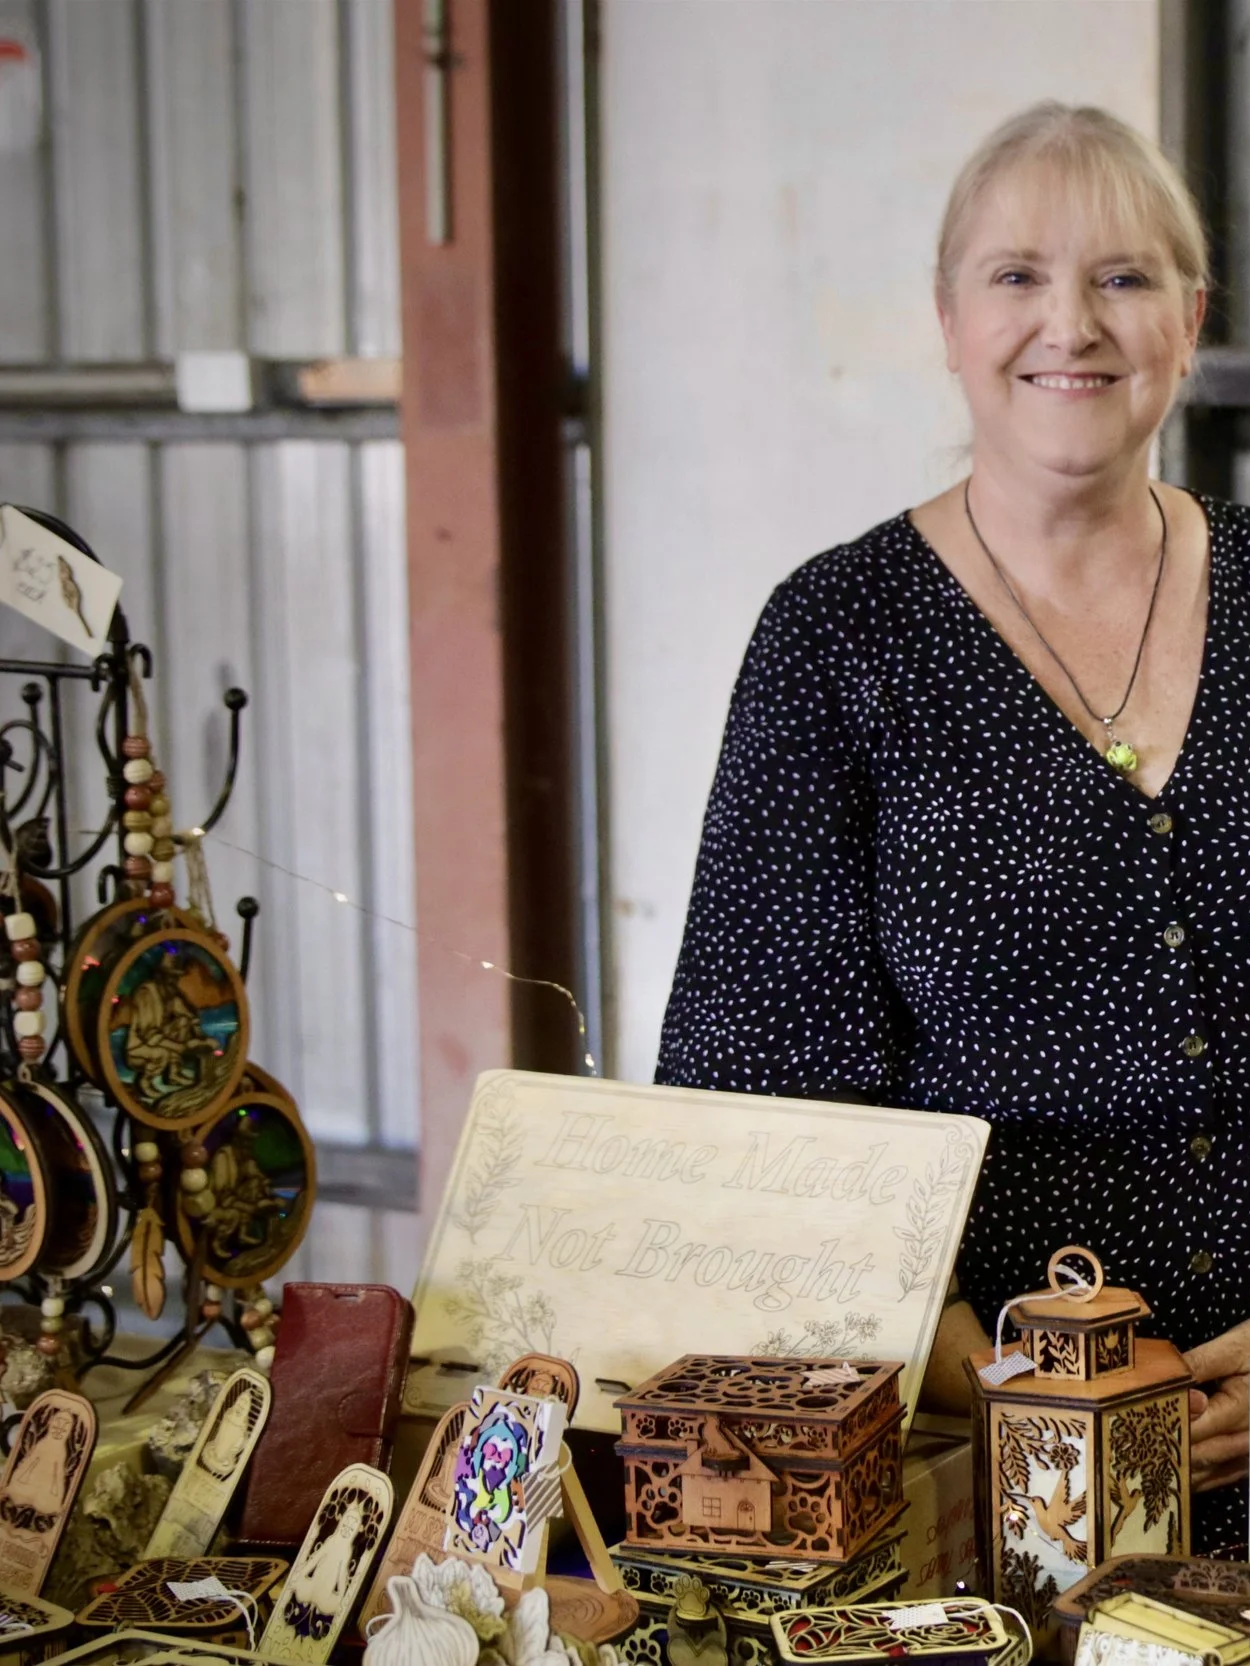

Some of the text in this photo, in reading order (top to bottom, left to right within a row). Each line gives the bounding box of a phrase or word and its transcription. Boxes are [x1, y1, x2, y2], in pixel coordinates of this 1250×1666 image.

[534, 1110, 909, 1206] Home Made
[494, 1203, 875, 1311] Not Brought
